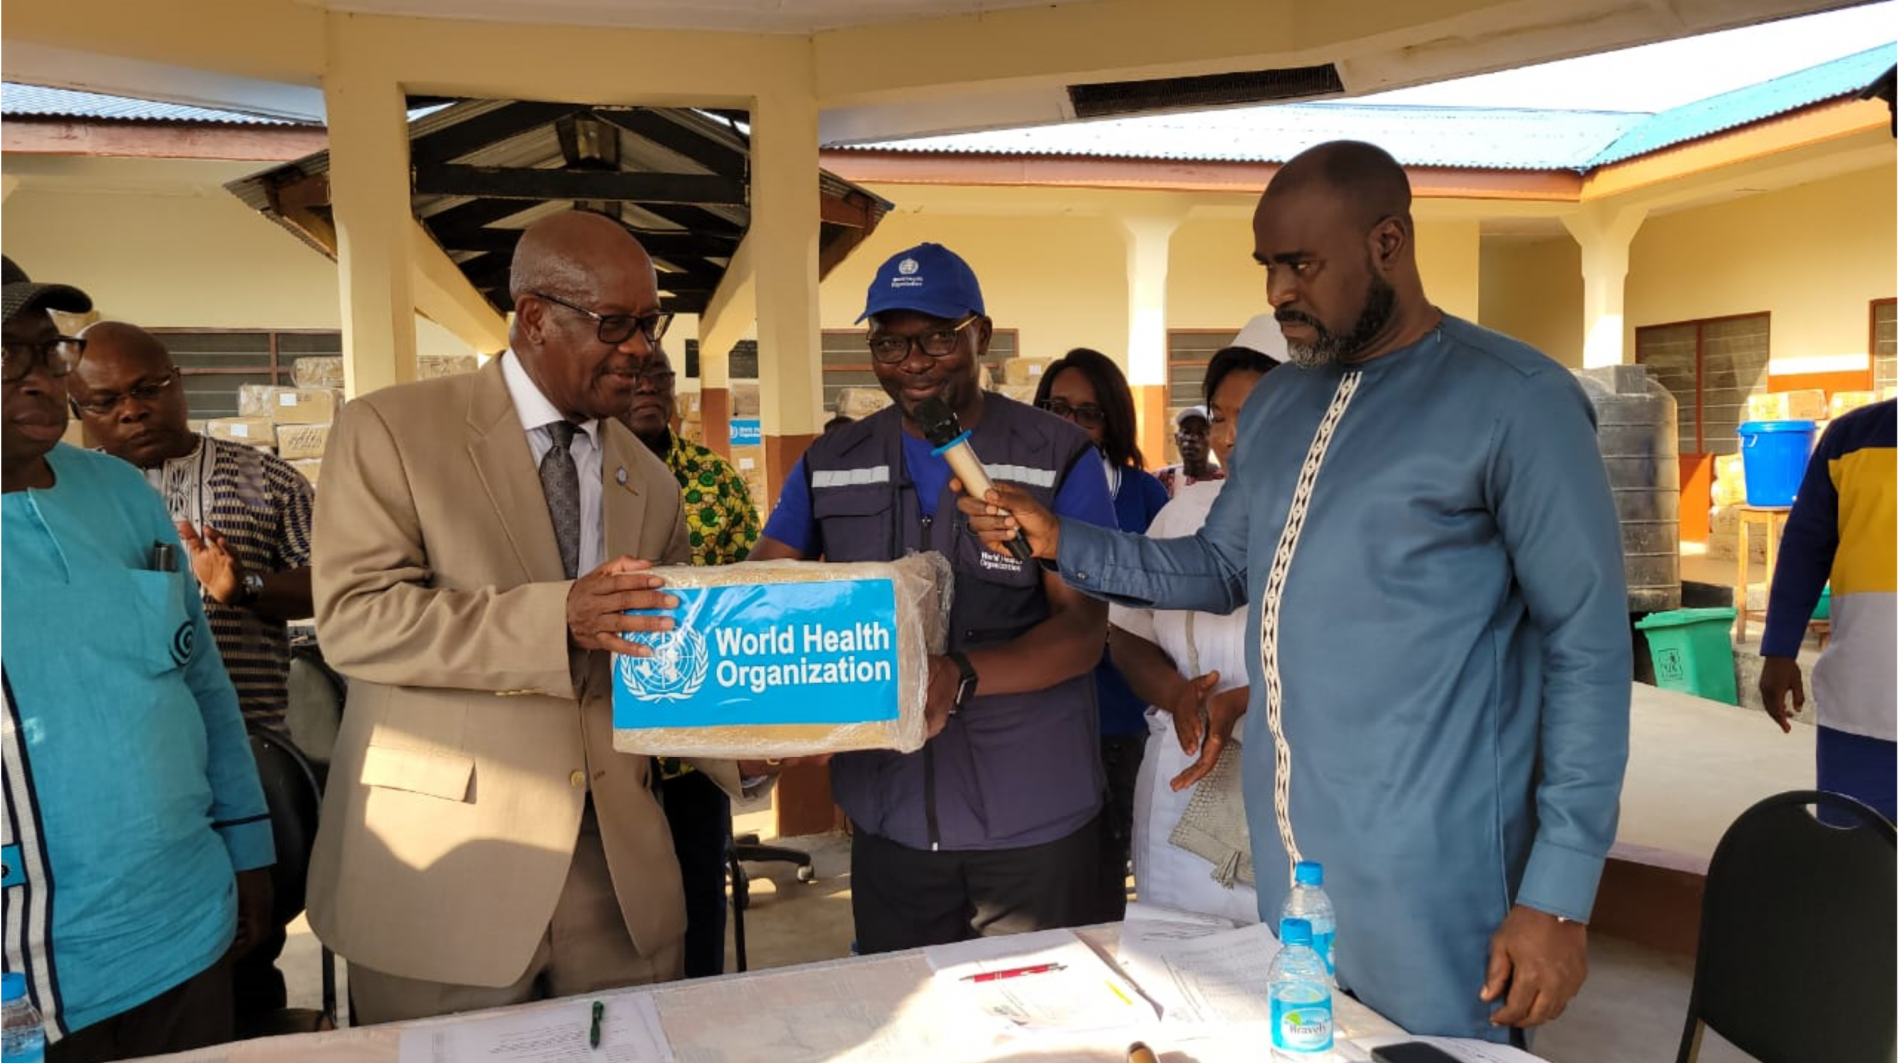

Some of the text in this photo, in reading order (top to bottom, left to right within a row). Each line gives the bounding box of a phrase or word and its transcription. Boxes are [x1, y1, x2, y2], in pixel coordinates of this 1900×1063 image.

[980, 559, 1022, 572] Organization
[981, 551, 1000, 562] World
[715, 621, 890, 657] World Health
[716, 655, 891, 693] Organization
